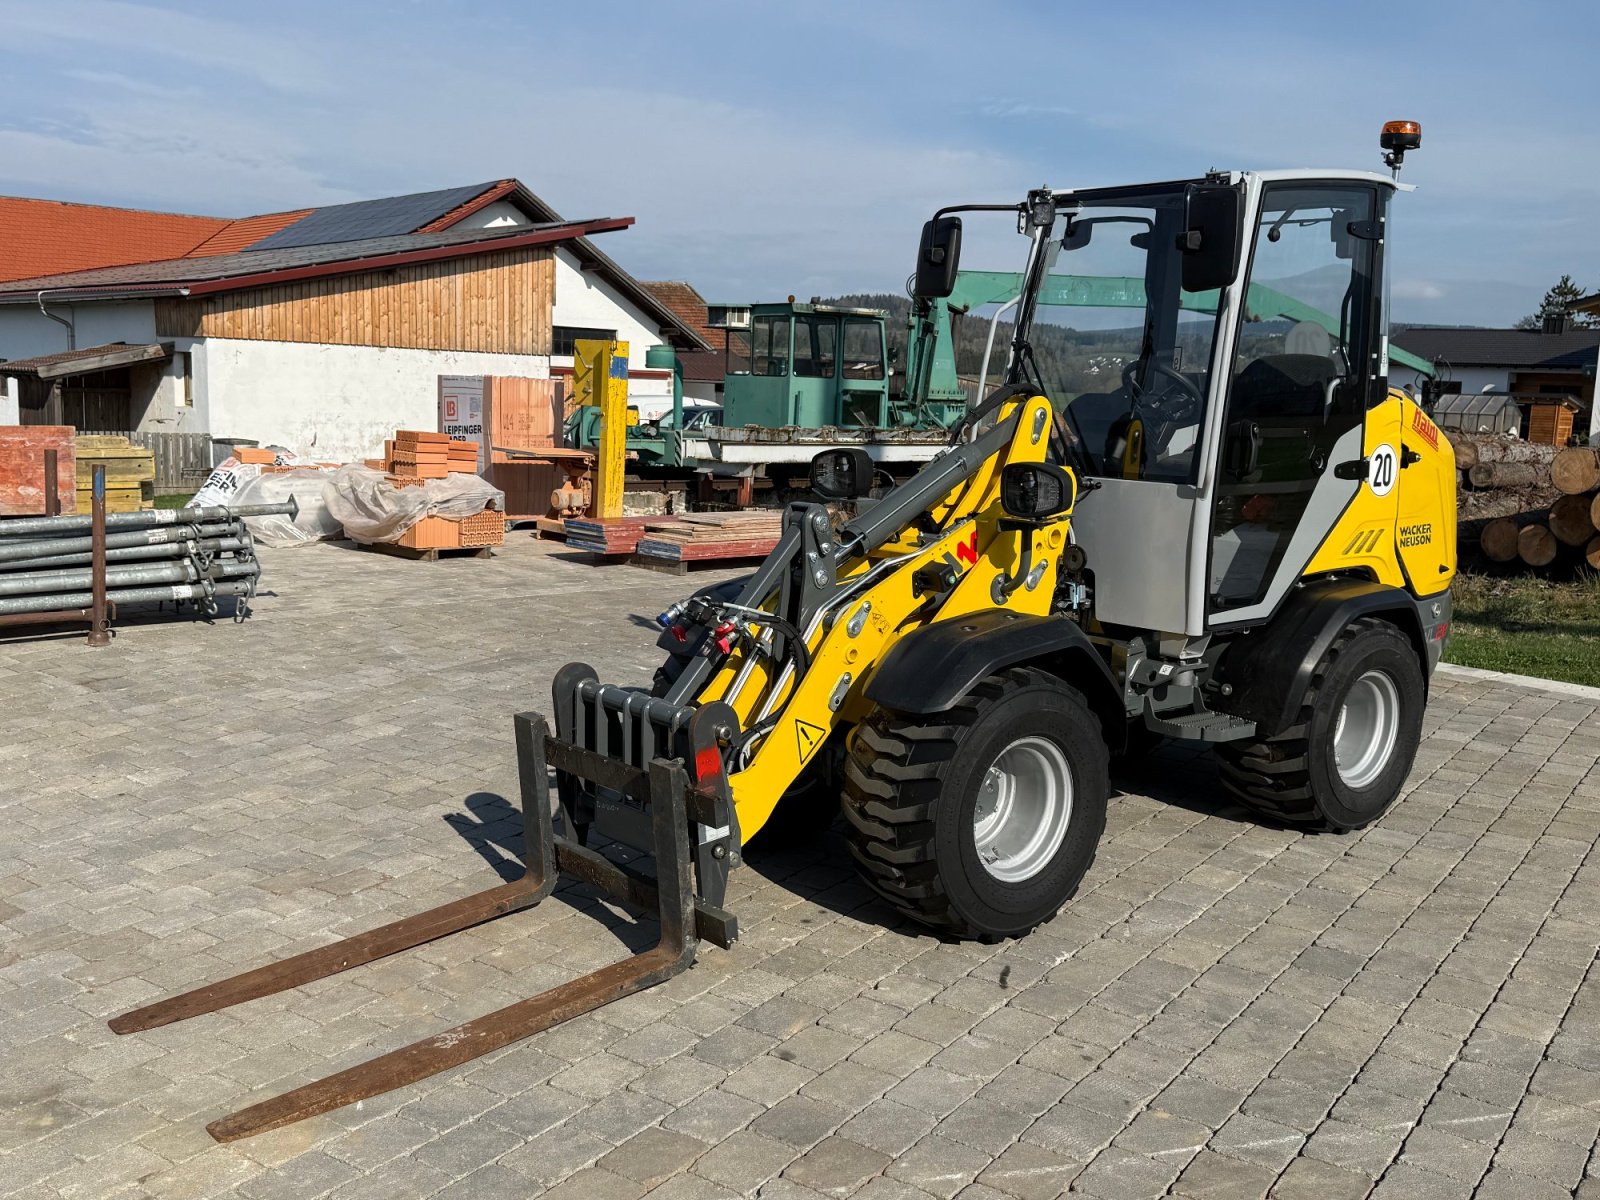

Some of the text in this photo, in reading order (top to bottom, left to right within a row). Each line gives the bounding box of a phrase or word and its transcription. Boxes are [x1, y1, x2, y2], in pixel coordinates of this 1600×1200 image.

[443, 424, 483, 435] LEIPFINGER
[1373, 453, 1392, 487] 20
[1400, 523, 1432, 537] WACKER
[1400, 534, 1431, 548] NEUSON
